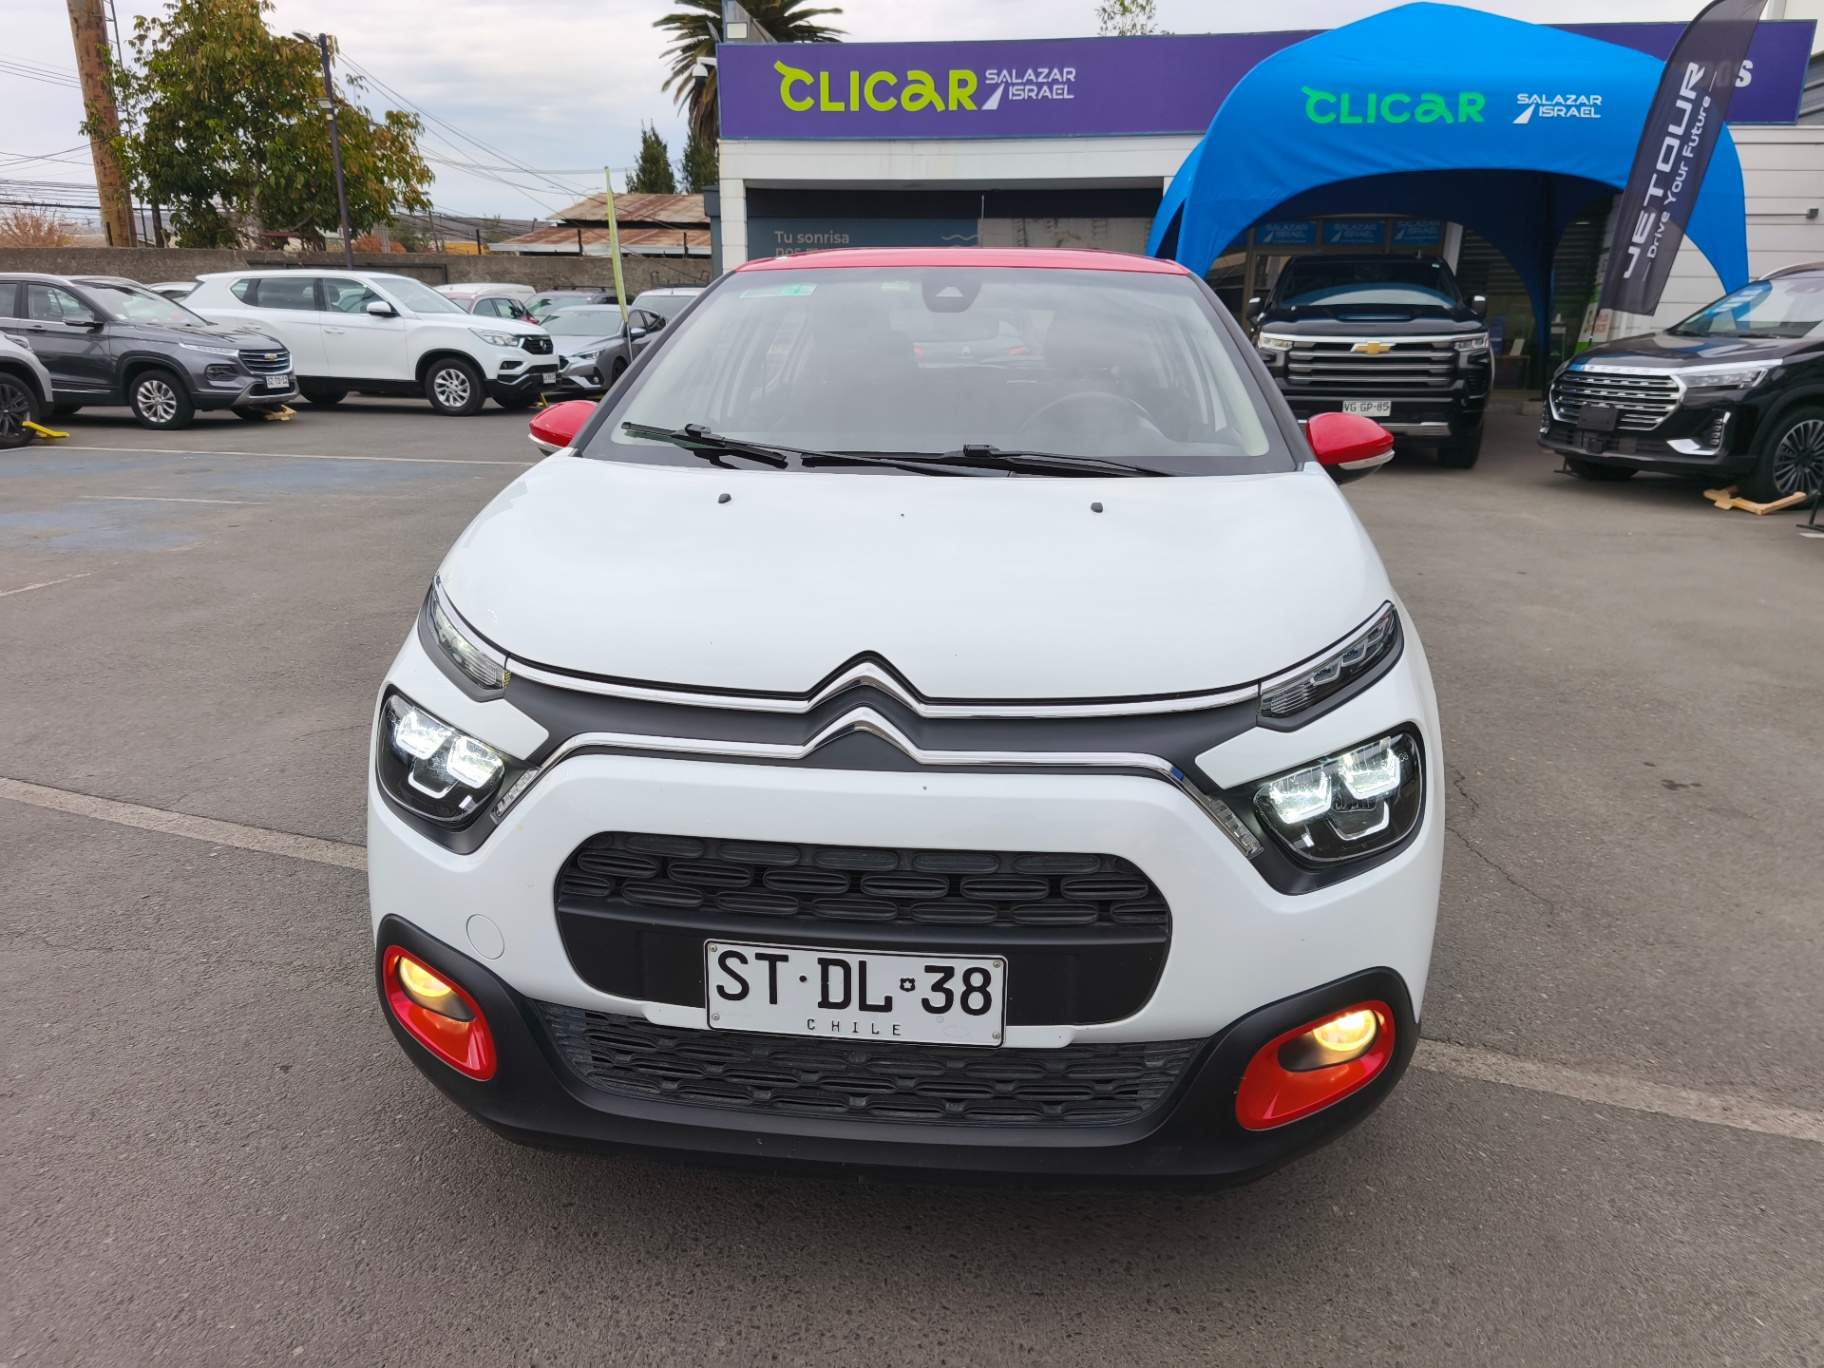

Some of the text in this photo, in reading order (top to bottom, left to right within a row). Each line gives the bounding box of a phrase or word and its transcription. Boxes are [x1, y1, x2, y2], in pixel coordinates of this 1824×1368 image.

[985, 68, 1076, 84] SALAZAR
[1008, 85, 1075, 100] ISRAEL
[1516, 93, 1603, 106] SALAZAR
[1538, 105, 1601, 118] ISRAEL
[1623, 62, 1705, 279] JETOUR
[1647, 96, 1711, 259] Drive Your Future
[774, 230, 850, 244] Tu sonrisa
[806, 1018, 902, 1037] CHILE
